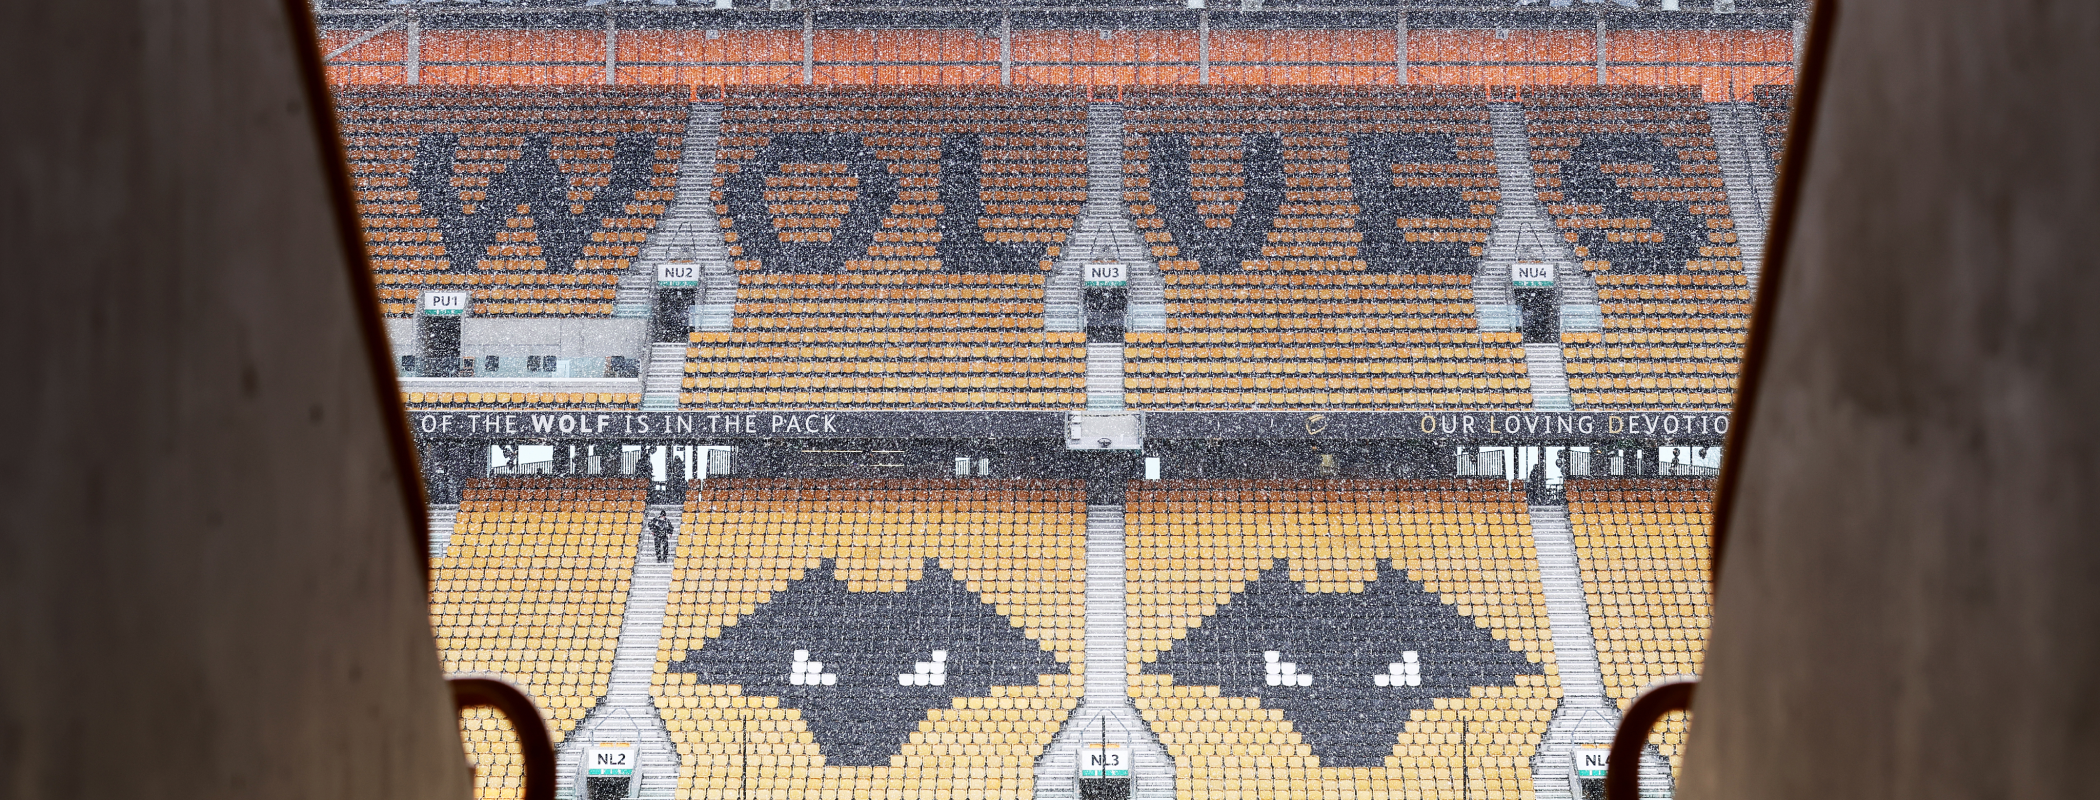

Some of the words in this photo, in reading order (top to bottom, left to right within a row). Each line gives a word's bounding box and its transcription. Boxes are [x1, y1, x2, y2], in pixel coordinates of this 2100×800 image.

[408, 132, 1710, 274] WOLVES
[664, 267, 692, 278] NU2
[1091, 267, 1120, 278] NU3
[1518, 267, 1547, 278] NU4
[433, 296, 459, 307] PU1
[421, 414, 452, 433] OF
[467, 414, 517, 433] THE
[531, 414, 610, 433] WOLF
[624, 414, 649, 433] IS
[664, 414, 692, 433] IN
[707, 414, 757, 433] THE
[771, 414, 837, 433] PACK
[1420, 414, 1475, 434] OUR
[1490, 414, 1593, 434] LOVING
[597, 753, 626, 766] NL2
[1091, 754, 1120, 767] NL3
